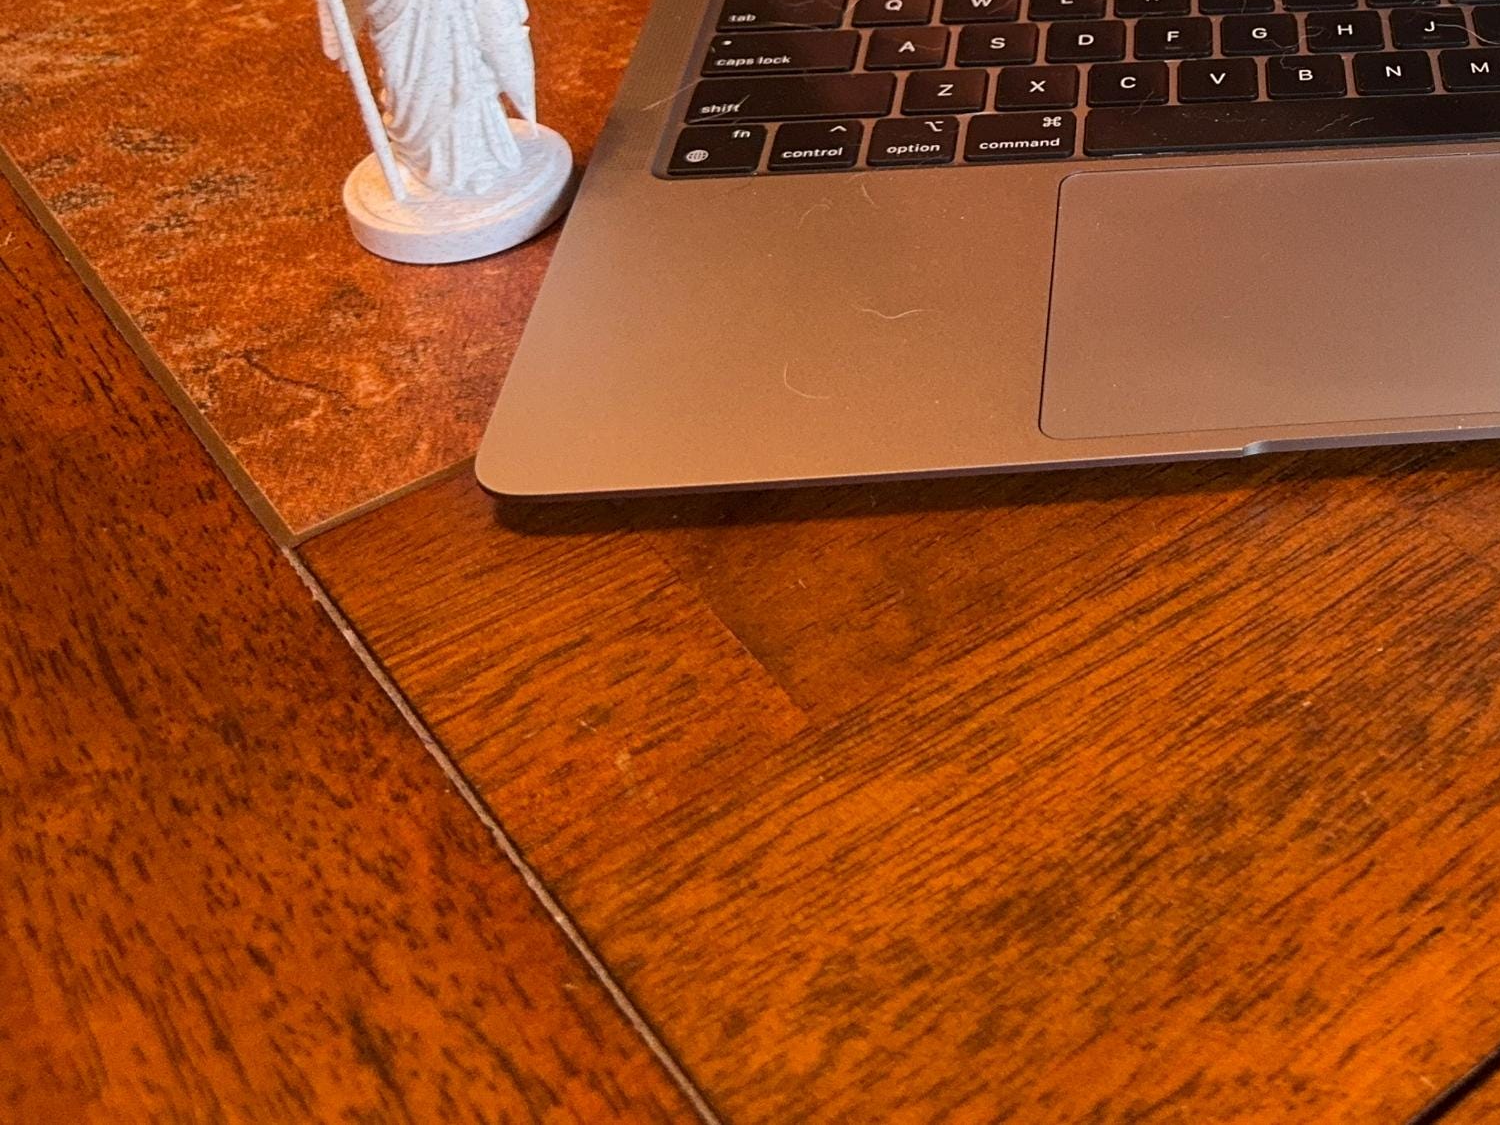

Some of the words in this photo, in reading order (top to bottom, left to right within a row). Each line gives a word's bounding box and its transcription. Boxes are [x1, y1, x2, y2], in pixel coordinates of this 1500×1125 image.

[885, 0, 903, 11] Q
[730, 14, 756, 22] tab
[1337, 24, 1353, 36] H
[1424, 20, 1435, 32] J
[1167, 30, 1180, 42] F
[1251, 27, 1268, 39] G
[990, 37, 1006, 49] S
[1078, 34, 1094, 46] D
[898, 41, 916, 53] A
[716, 58, 754, 67] caps
[758, 55, 790, 65] lock
[1385, 65, 1402, 78] N
[1470, 61, 1490, 74] M
[1209, 72, 1226, 85] V
[1298, 69, 1313, 81] B
[1029, 80, 1046, 93] X
[1120, 76, 1136, 89] C
[937, 84, 954, 97] Z
[701, 103, 741, 114] shift
[733, 129, 751, 138] fn
[886, 143, 941, 155] option
[979, 137, 1060, 150] command
[782, 146, 843, 159] control
